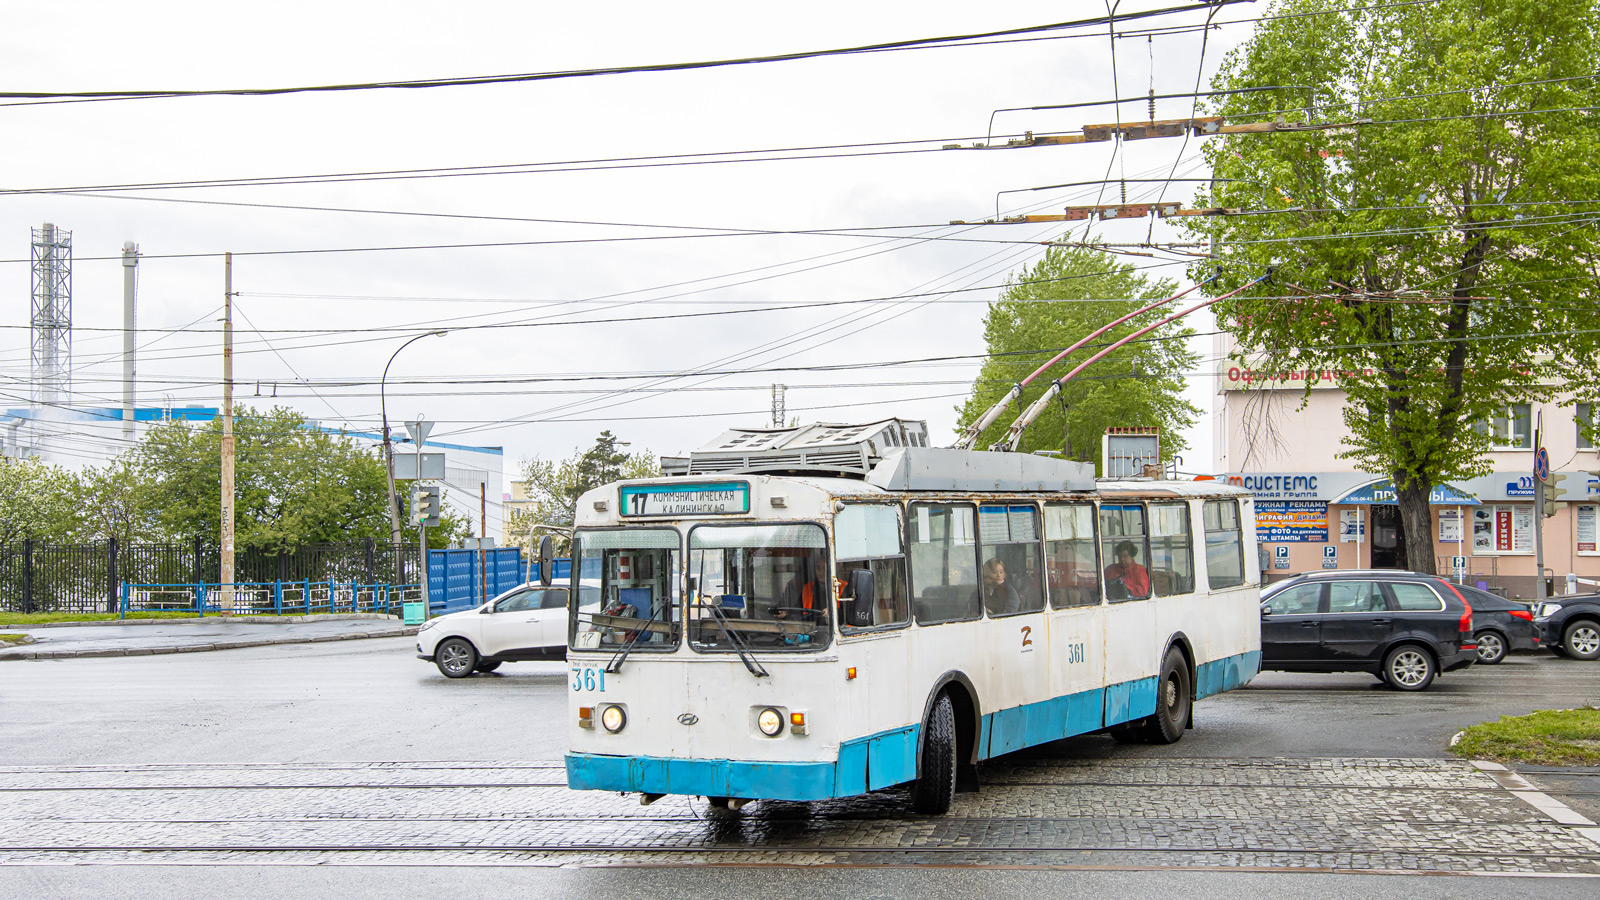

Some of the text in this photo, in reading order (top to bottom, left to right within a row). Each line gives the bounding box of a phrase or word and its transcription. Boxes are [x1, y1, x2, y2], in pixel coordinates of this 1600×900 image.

[631, 493, 648, 514] 17
[653, 491, 735, 503] КОММУНИСТИЧЕСКАЯ
[662, 503, 725, 514] КАЛИНИНСКАЯ
[1296, 513, 1327, 521] ДИЗАЙН
[856, 611, 870, 620] 361
[582, 632, 595, 647] 17
[1068, 643, 1084, 664] 361
[571, 668, 606, 692] 361
